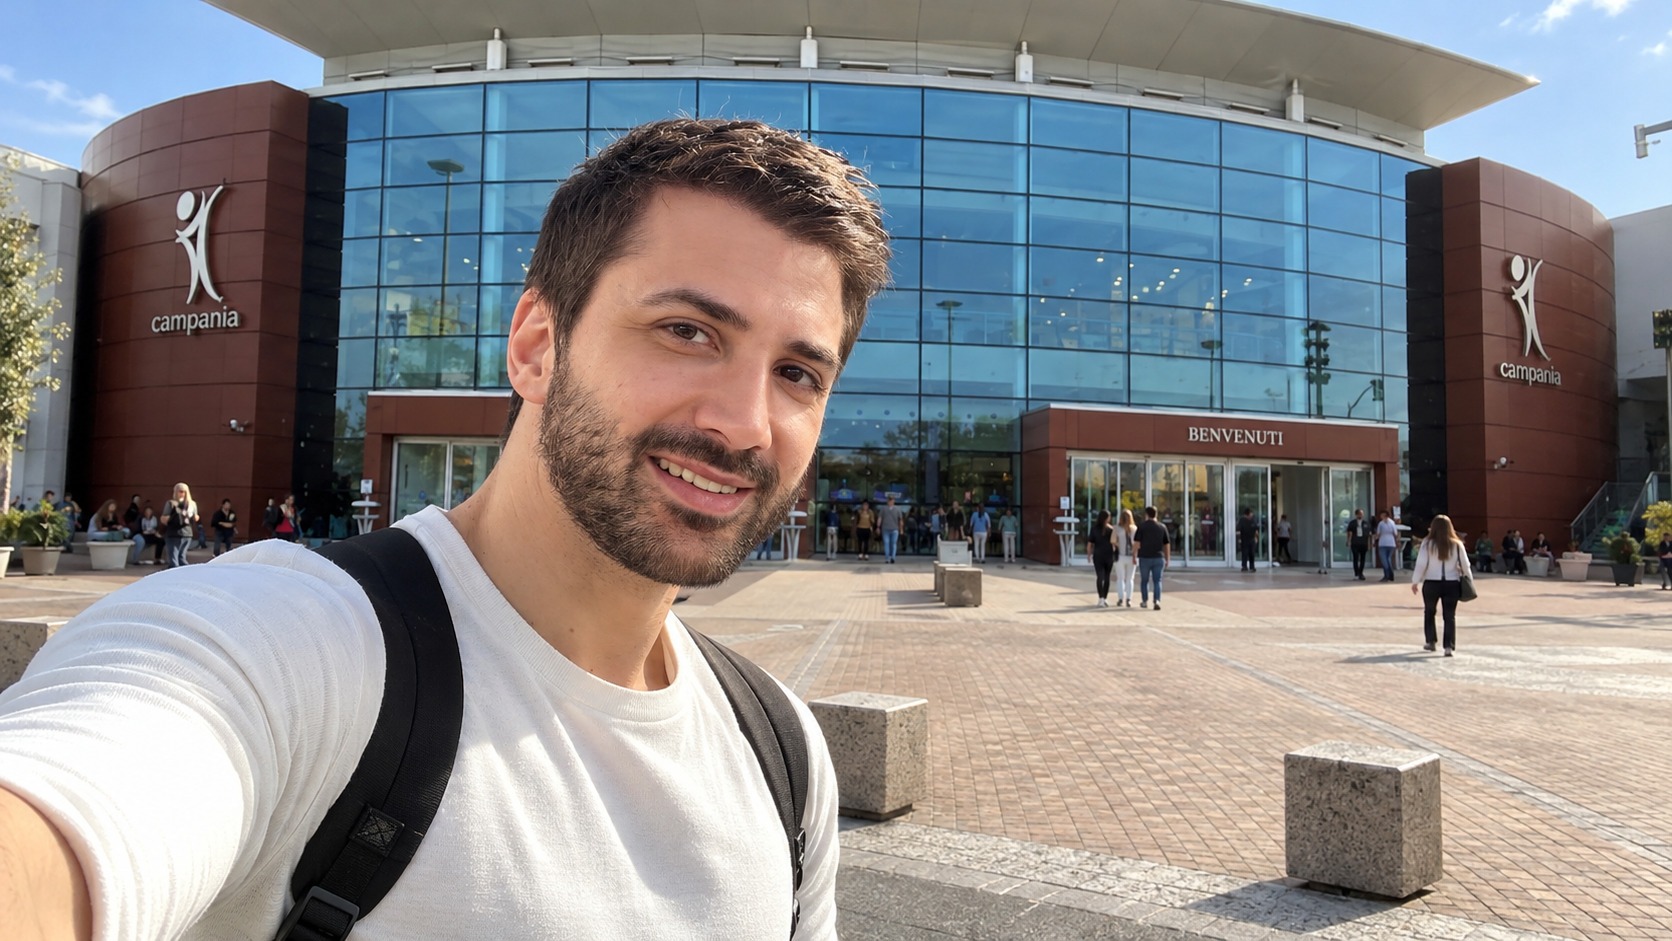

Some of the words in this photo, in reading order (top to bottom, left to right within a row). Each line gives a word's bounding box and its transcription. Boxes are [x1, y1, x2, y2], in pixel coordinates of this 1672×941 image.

[151, 305, 239, 336] campania
[1500, 362, 1562, 386] campania
[1188, 427, 1284, 445] BENVENUTI
